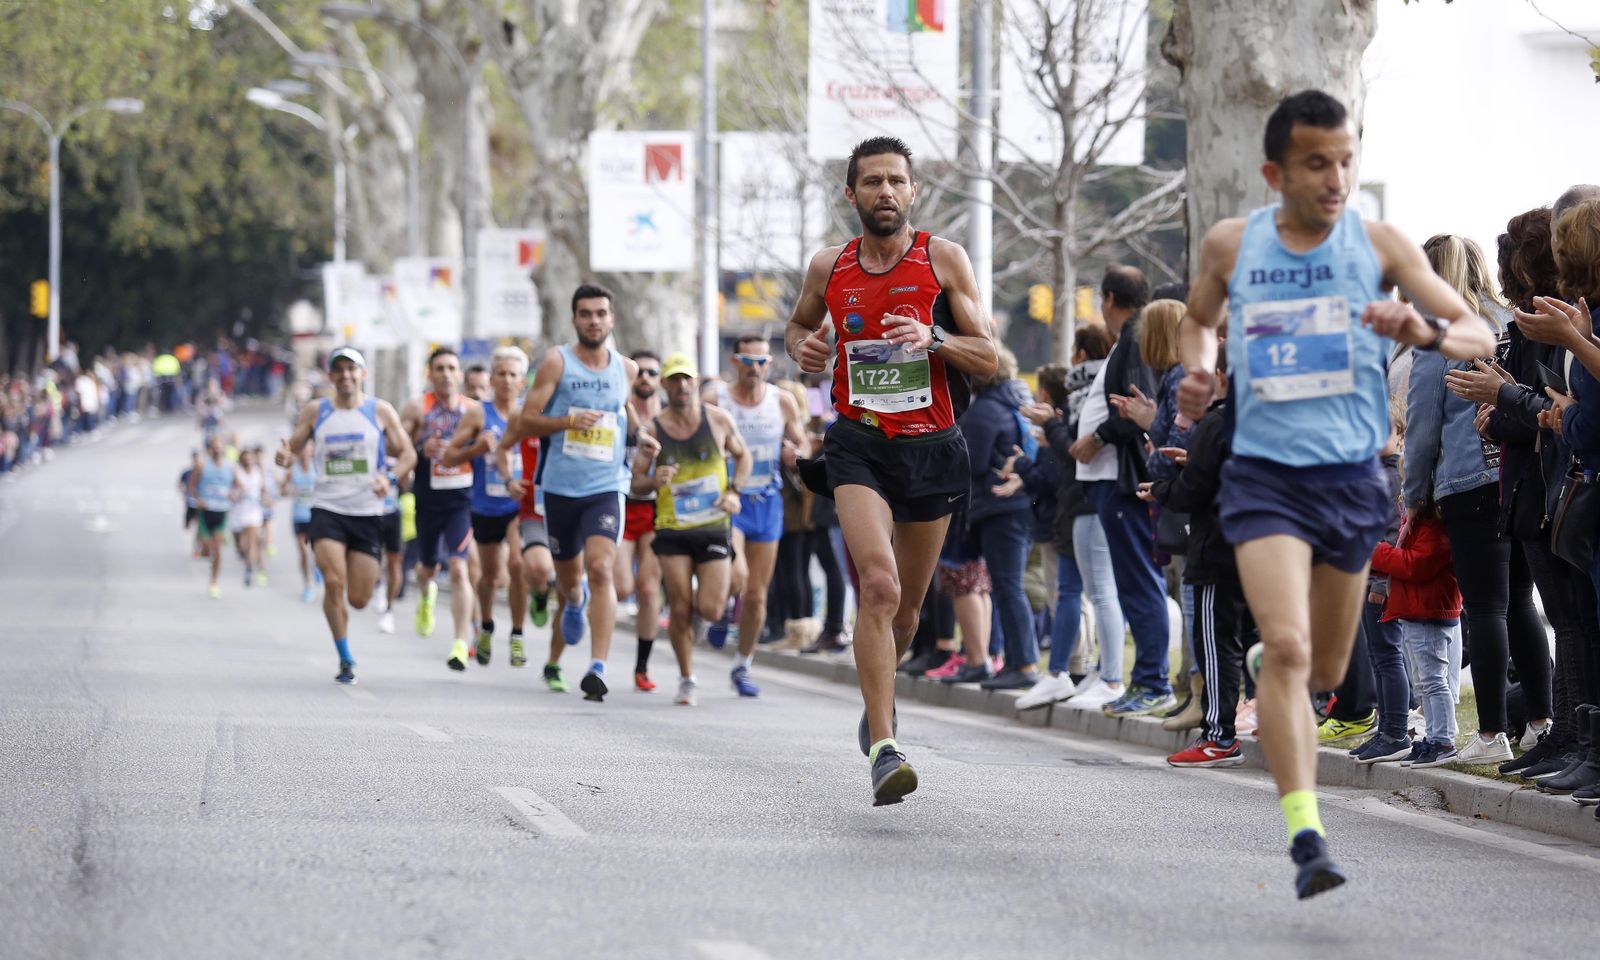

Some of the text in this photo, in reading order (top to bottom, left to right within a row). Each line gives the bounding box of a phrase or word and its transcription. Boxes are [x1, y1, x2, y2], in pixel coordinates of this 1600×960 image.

[1249, 262, 1335, 289] nerja
[1266, 342, 1298, 367] 12
[571, 378, 611, 392] nerja
[856, 368, 901, 386] 1722
